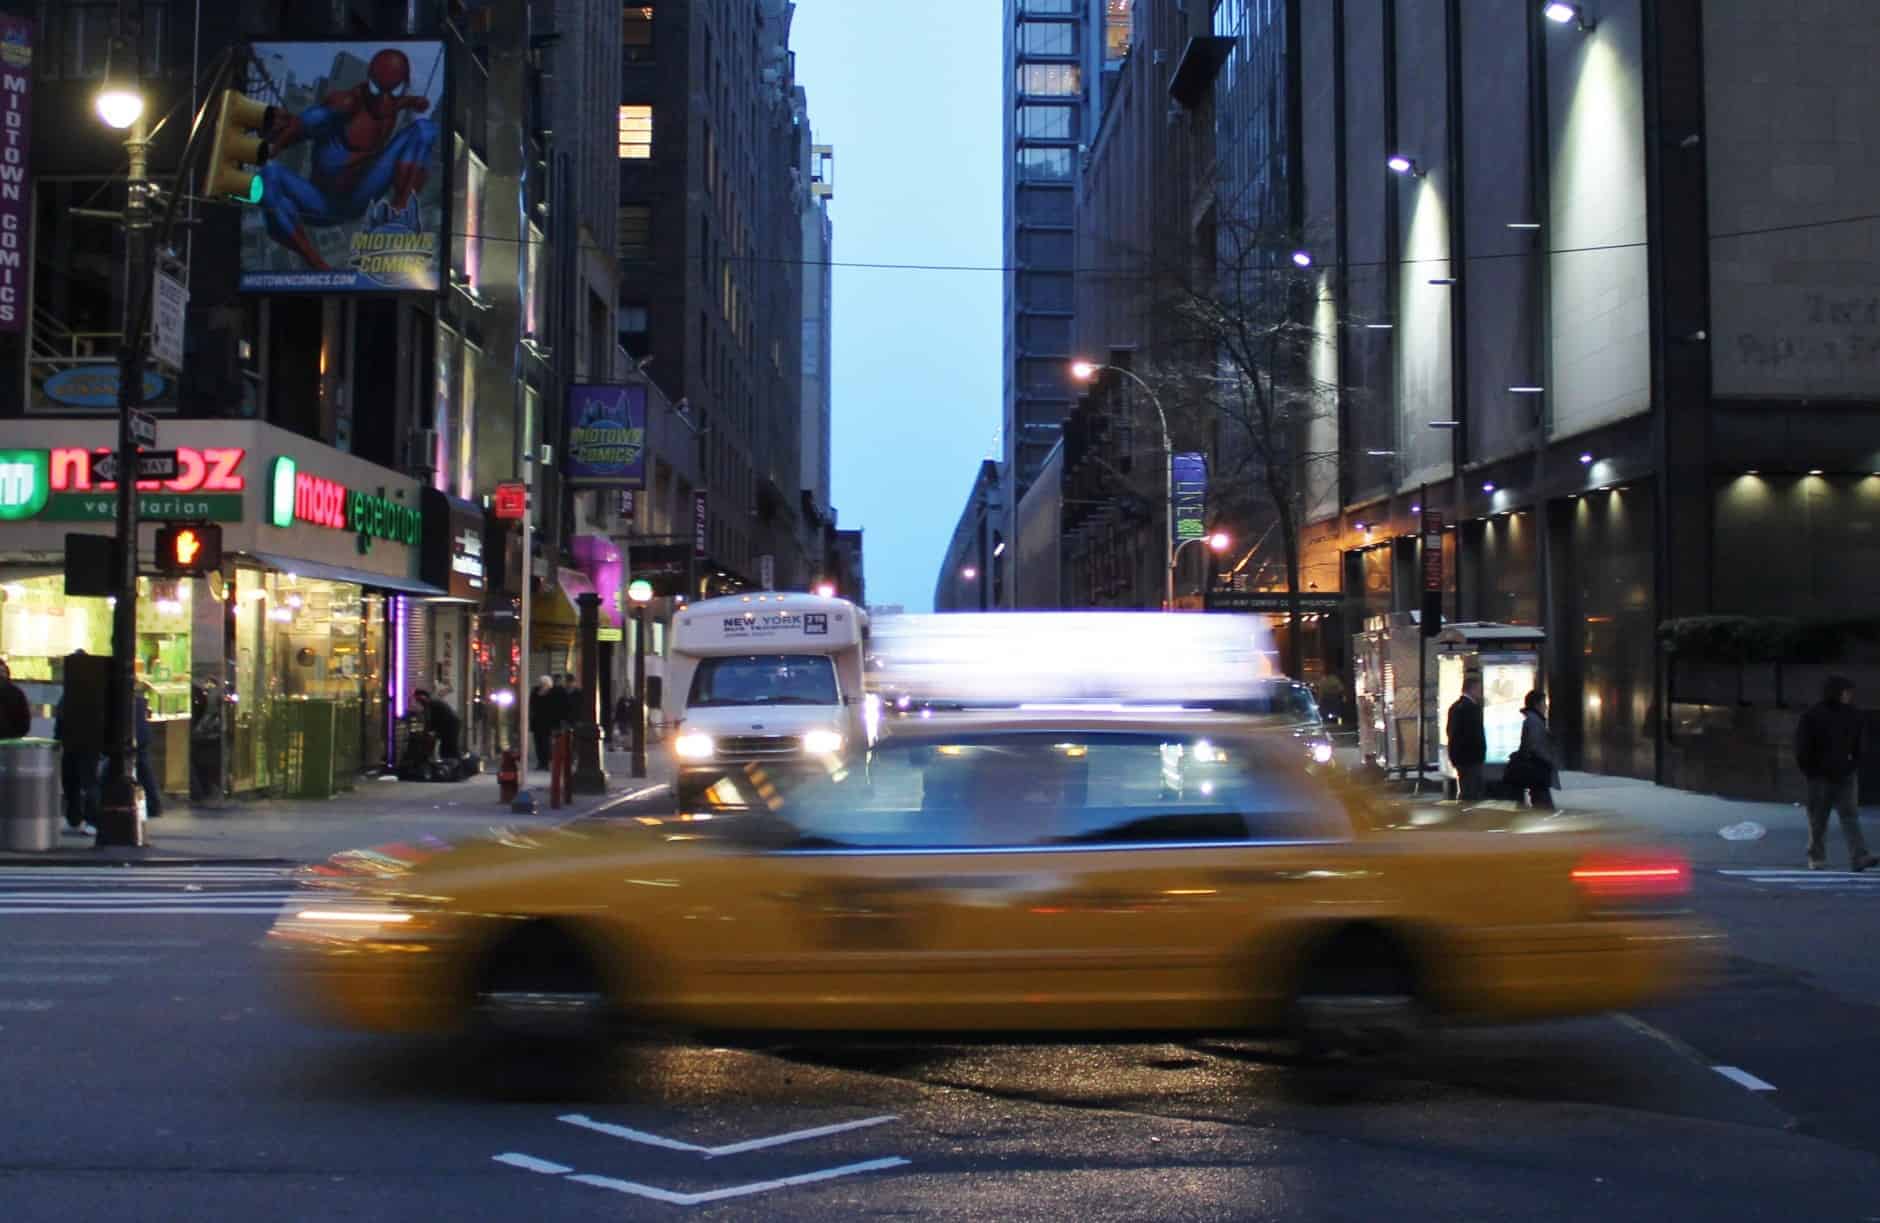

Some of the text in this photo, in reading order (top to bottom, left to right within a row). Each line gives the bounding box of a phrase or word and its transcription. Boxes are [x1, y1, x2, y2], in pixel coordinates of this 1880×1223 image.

[0, 75, 26, 200] MIDTOWN
[0, 214, 20, 321] COMICS
[723, 617, 755, 626] NEW
[763, 615, 801, 625] YORK
